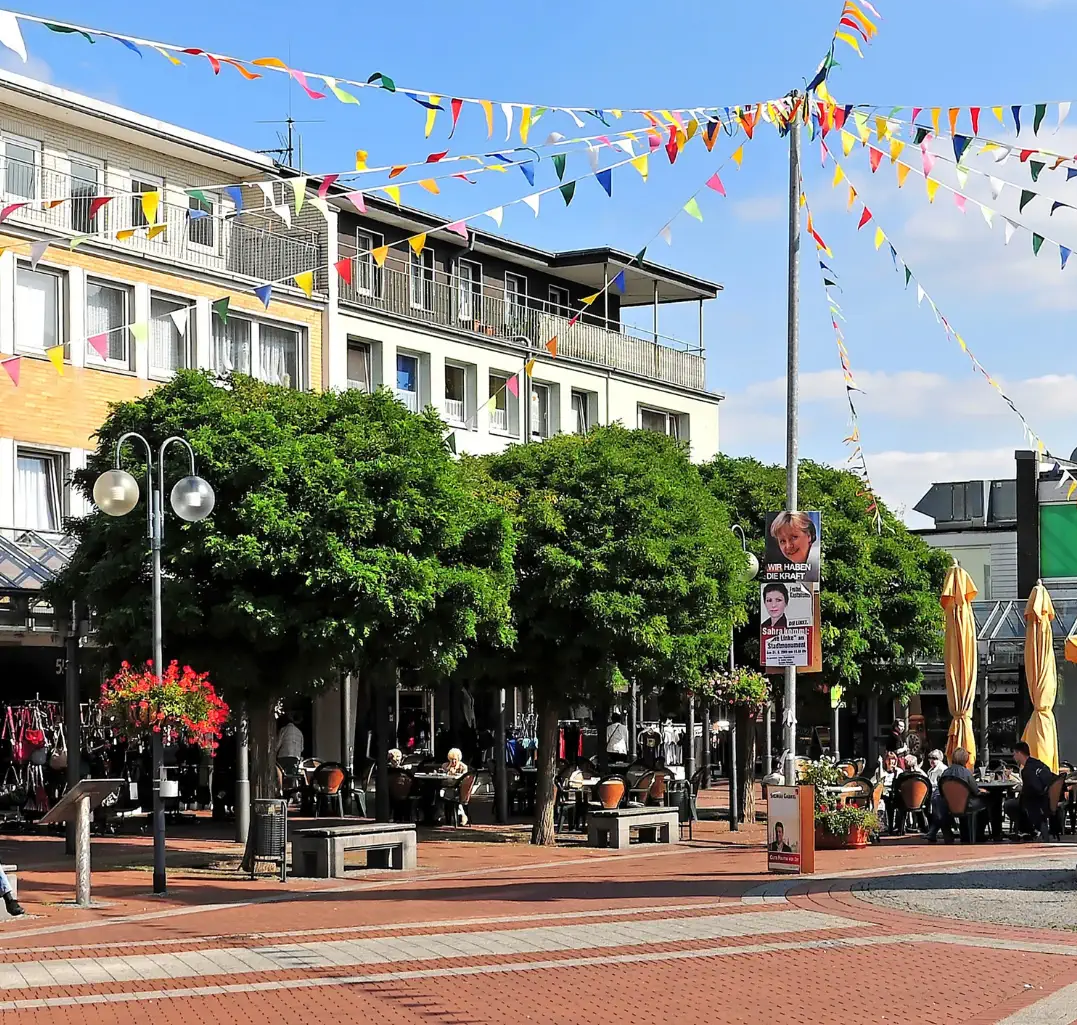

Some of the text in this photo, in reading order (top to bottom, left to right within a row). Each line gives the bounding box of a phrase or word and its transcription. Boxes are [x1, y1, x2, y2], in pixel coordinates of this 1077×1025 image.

[767, 563, 811, 571] WIR HABEN
[767, 572, 805, 580] DIE KRAFT
[762, 627, 782, 635] Sahra
